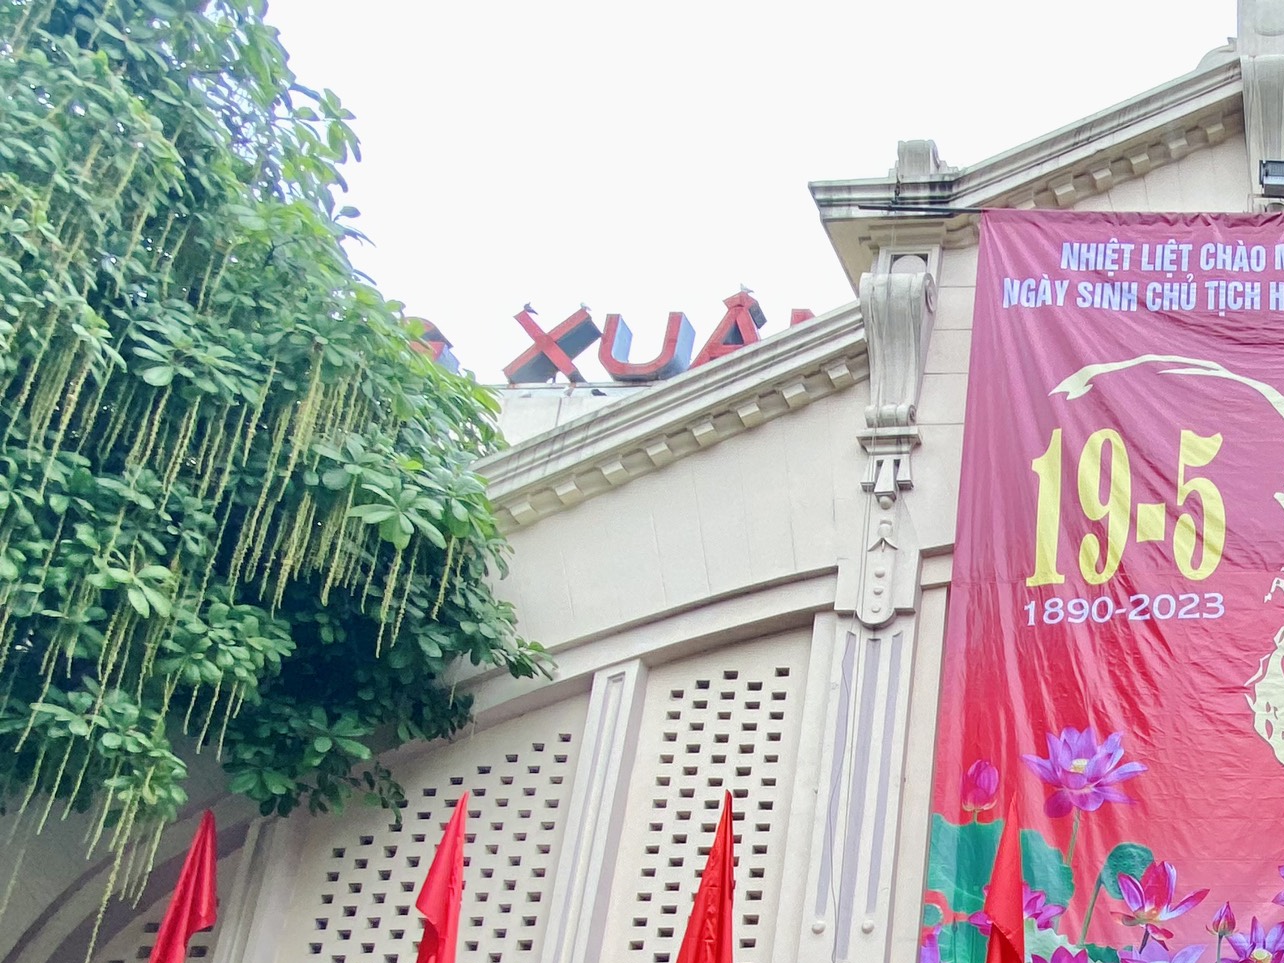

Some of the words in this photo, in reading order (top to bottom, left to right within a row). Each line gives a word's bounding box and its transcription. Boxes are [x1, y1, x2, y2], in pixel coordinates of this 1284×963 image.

[1060, 238, 1135, 277] NHIỆT
[1141, 238, 1193, 278] LIỆT
[1200, 240, 1266, 272] CHÀO
[1002, 273, 1070, 309] NGÀY
[1076, 281, 1138, 312] SINH
[1146, 273, 1197, 312] CHỦ
[1204, 280, 1261, 317] TỊCH
[502, 290, 816, 384] XUÂ
[1026, 428, 1226, 587] 19-5
[1024, 593, 1225, 626] 1890-2023
